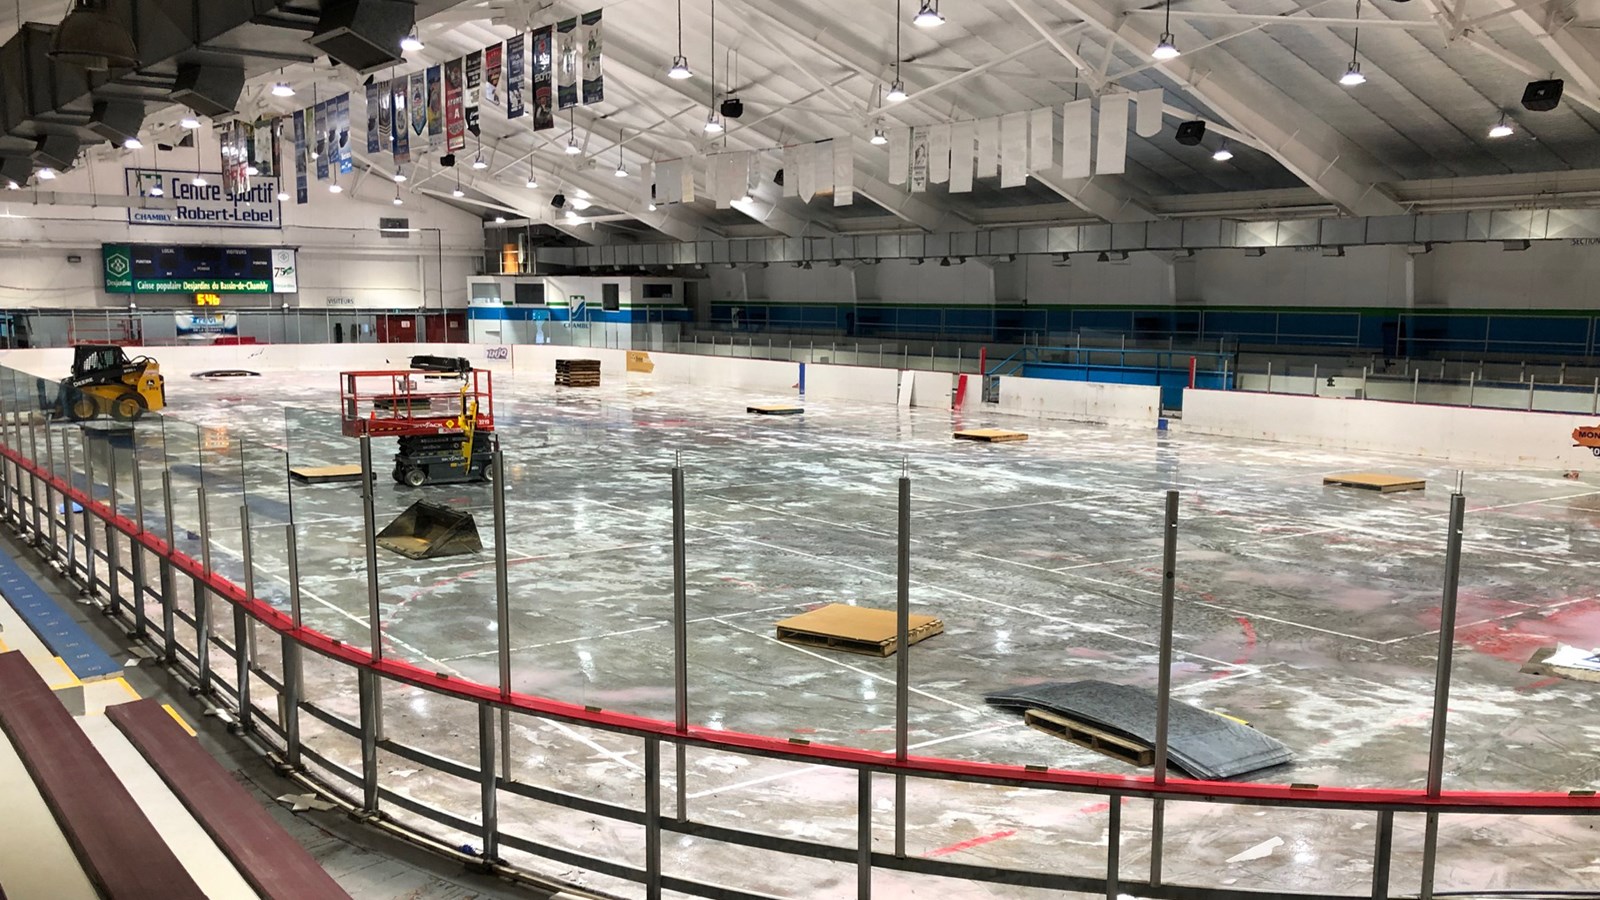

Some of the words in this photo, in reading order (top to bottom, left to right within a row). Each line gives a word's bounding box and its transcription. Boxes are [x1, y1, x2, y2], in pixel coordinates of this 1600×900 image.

[172, 178, 220, 201] Centre
[134, 213, 171, 221] CHAMBLY
[177, 206, 273, 222] Robert-Lebel
[106, 279, 132, 288] Desjardins
[137, 280, 155, 290] Caisse
[156, 281, 182, 292] populaire
[183, 280, 211, 292] Desjardins
[211, 281, 220, 290] du
[220, 281, 269, 293] Bassin-de-Chambly
[72, 377, 94, 388] DEERE
